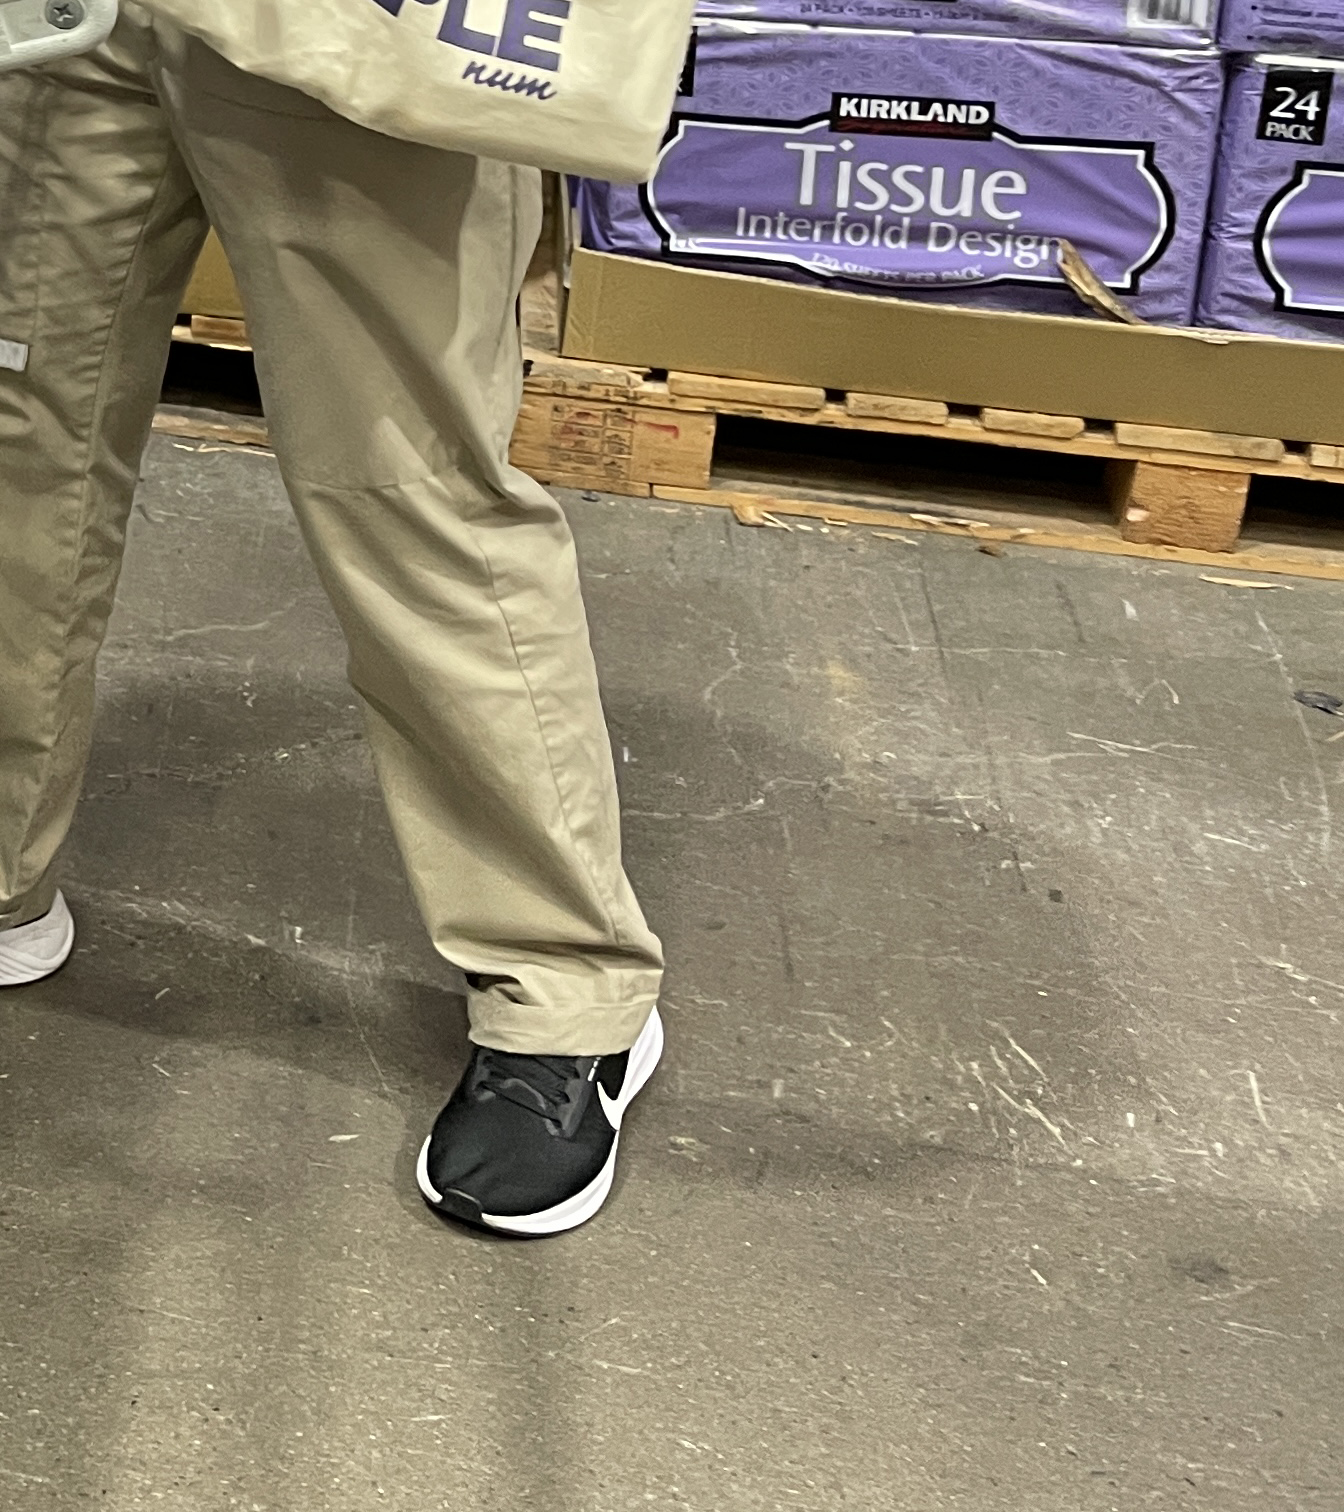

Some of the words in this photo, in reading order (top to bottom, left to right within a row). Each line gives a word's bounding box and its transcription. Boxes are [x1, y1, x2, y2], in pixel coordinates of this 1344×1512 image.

[463, 61, 557, 100] num
[839, 97, 990, 125] KIRKLAND
[1269, 87, 1321, 121] 24
[1265, 122, 1314, 141] PACK
[785, 141, 1028, 220] Tissue
[736, 207, 910, 251] Interfold
[927, 224, 1065, 268] Design
